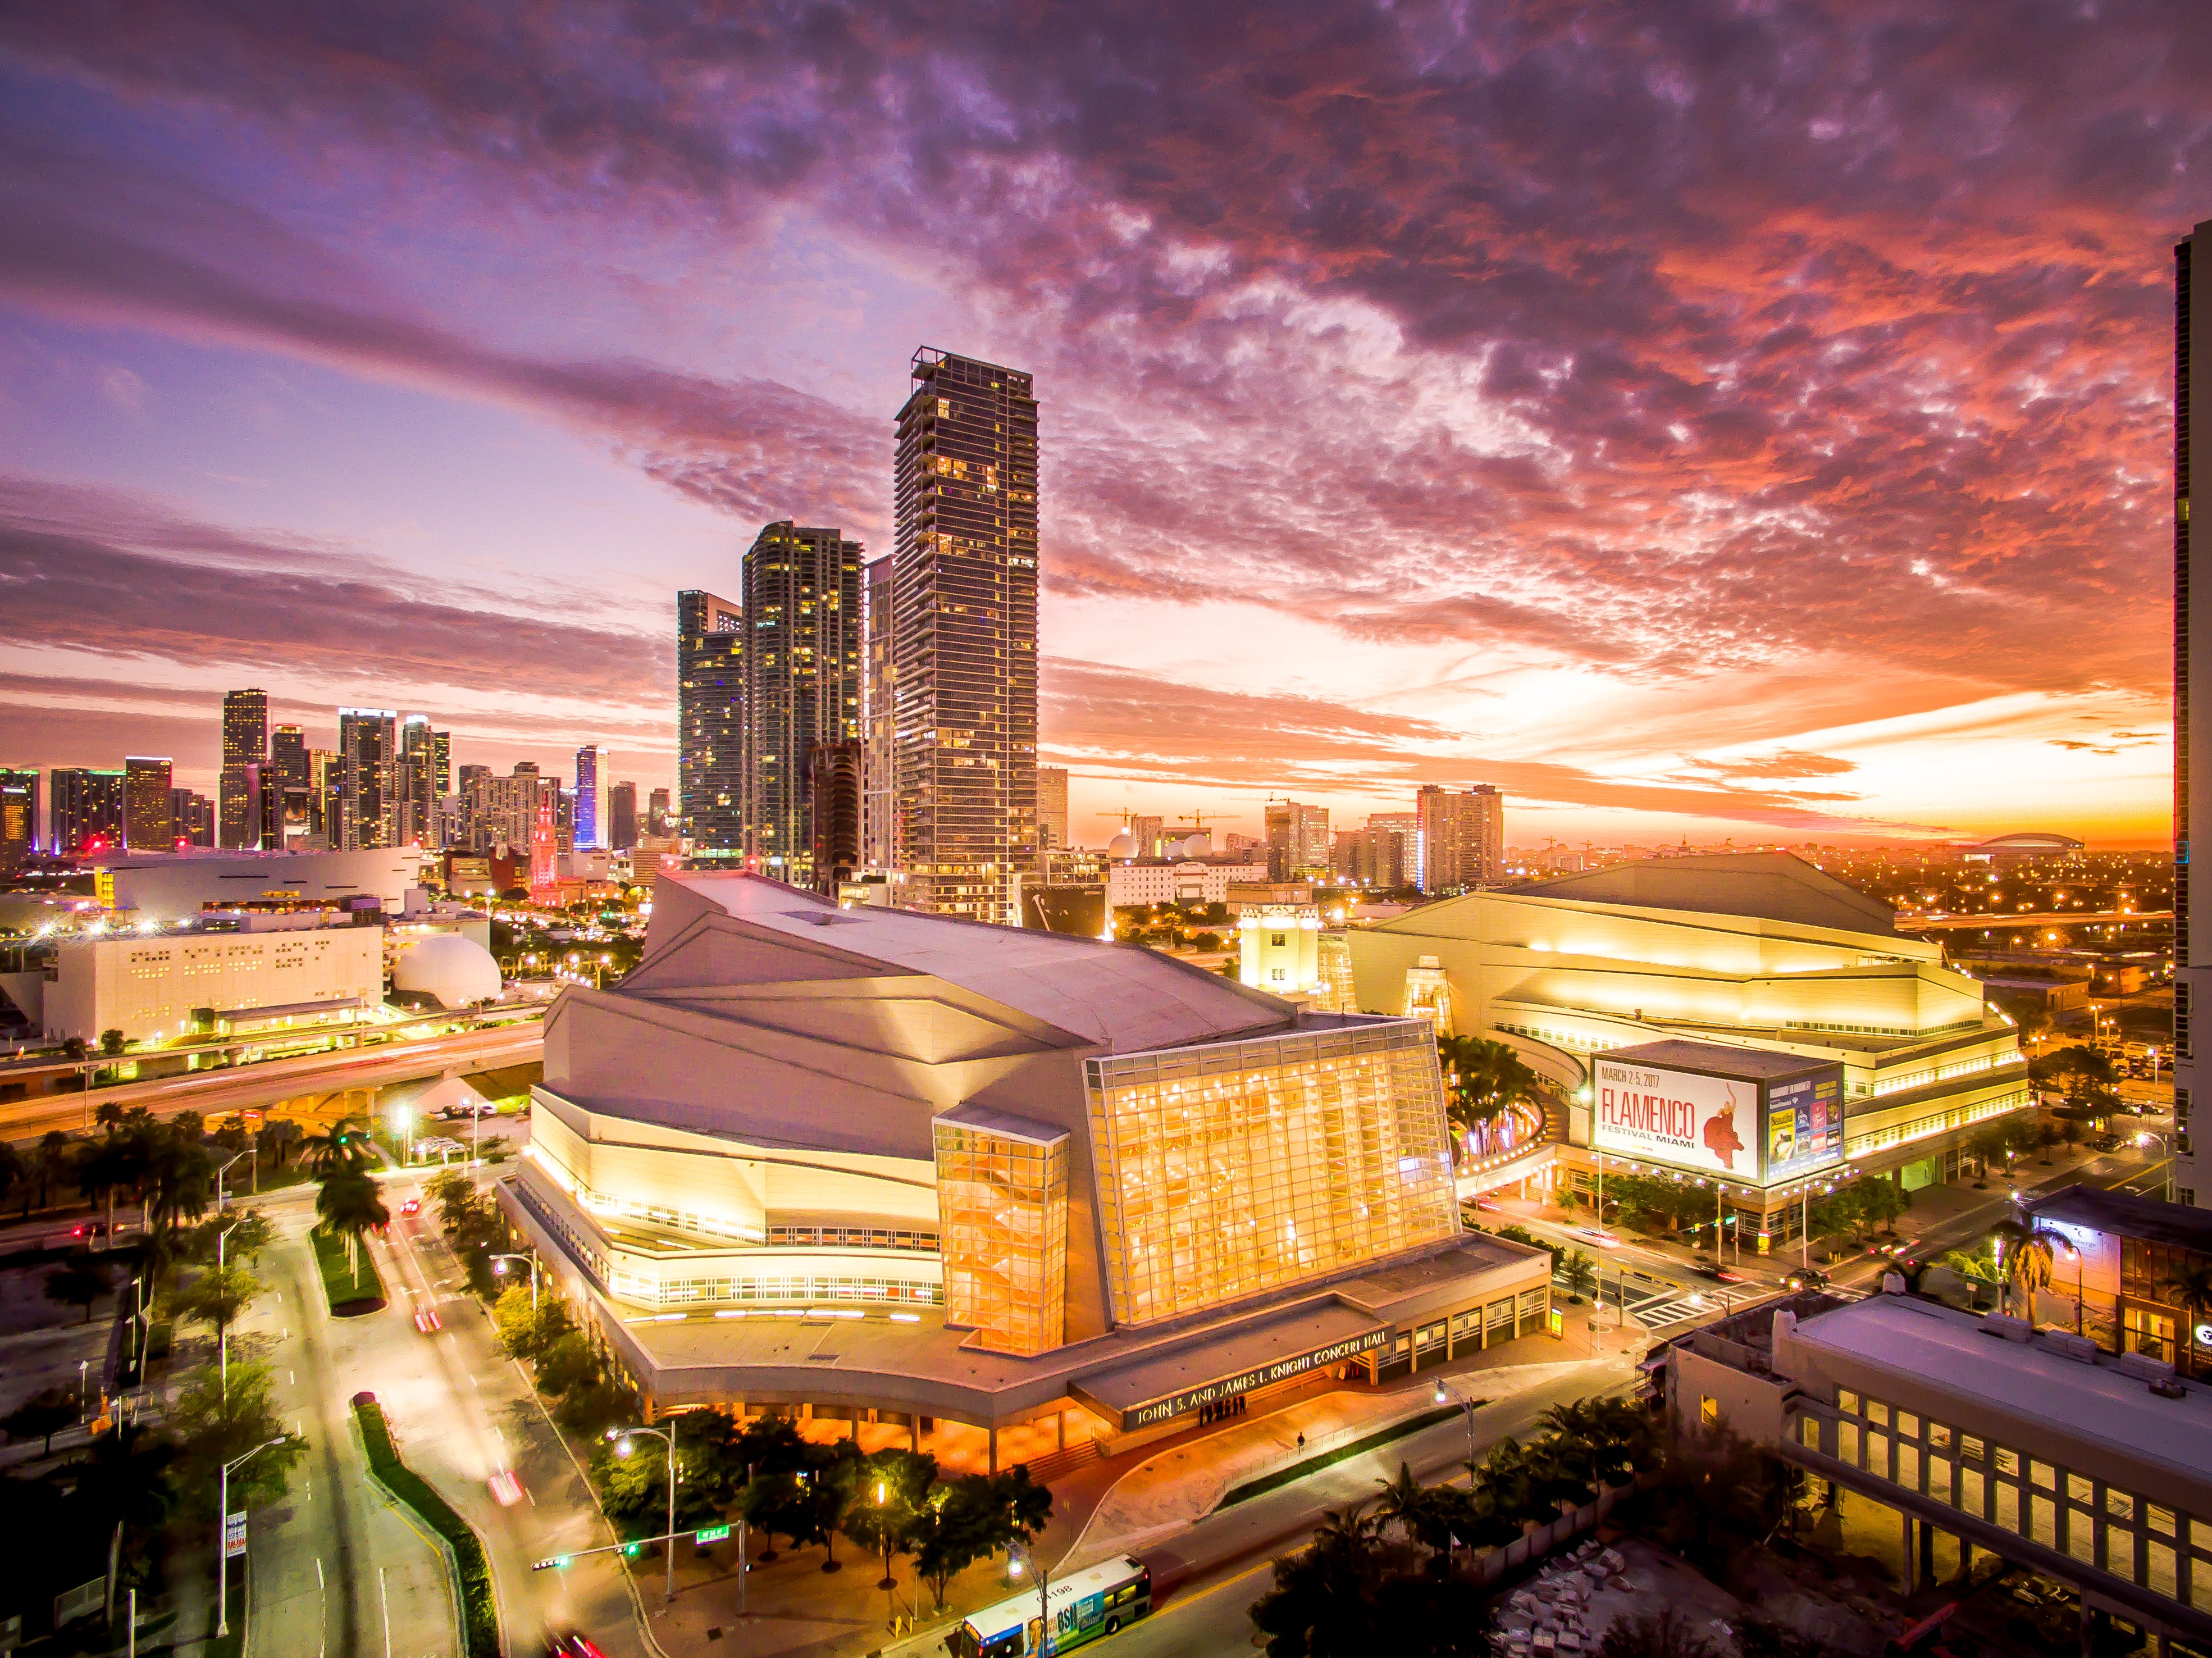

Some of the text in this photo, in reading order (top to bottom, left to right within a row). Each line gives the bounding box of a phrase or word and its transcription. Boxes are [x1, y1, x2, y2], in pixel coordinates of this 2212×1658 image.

[1602, 1067, 1659, 1088] MARCH 2-5, 2017
[1602, 1087, 1695, 1140] FLAMENCO
[1602, 1124, 1695, 1149] FESTIVAL MIAMI
[1137, 1399, 1173, 1424] JOHN
[1177, 1397, 1186, 1411] S.
[1191, 1388, 1216, 1406] AND
[1220, 1374, 1255, 1397] JAMES
[1271, 1356, 1310, 1380] KNIGHT
[1314, 1340, 1360, 1365] CONCERT
[1364, 1331, 1386, 1349] HALL
[1057, 1602, 1078, 1632] BSN
